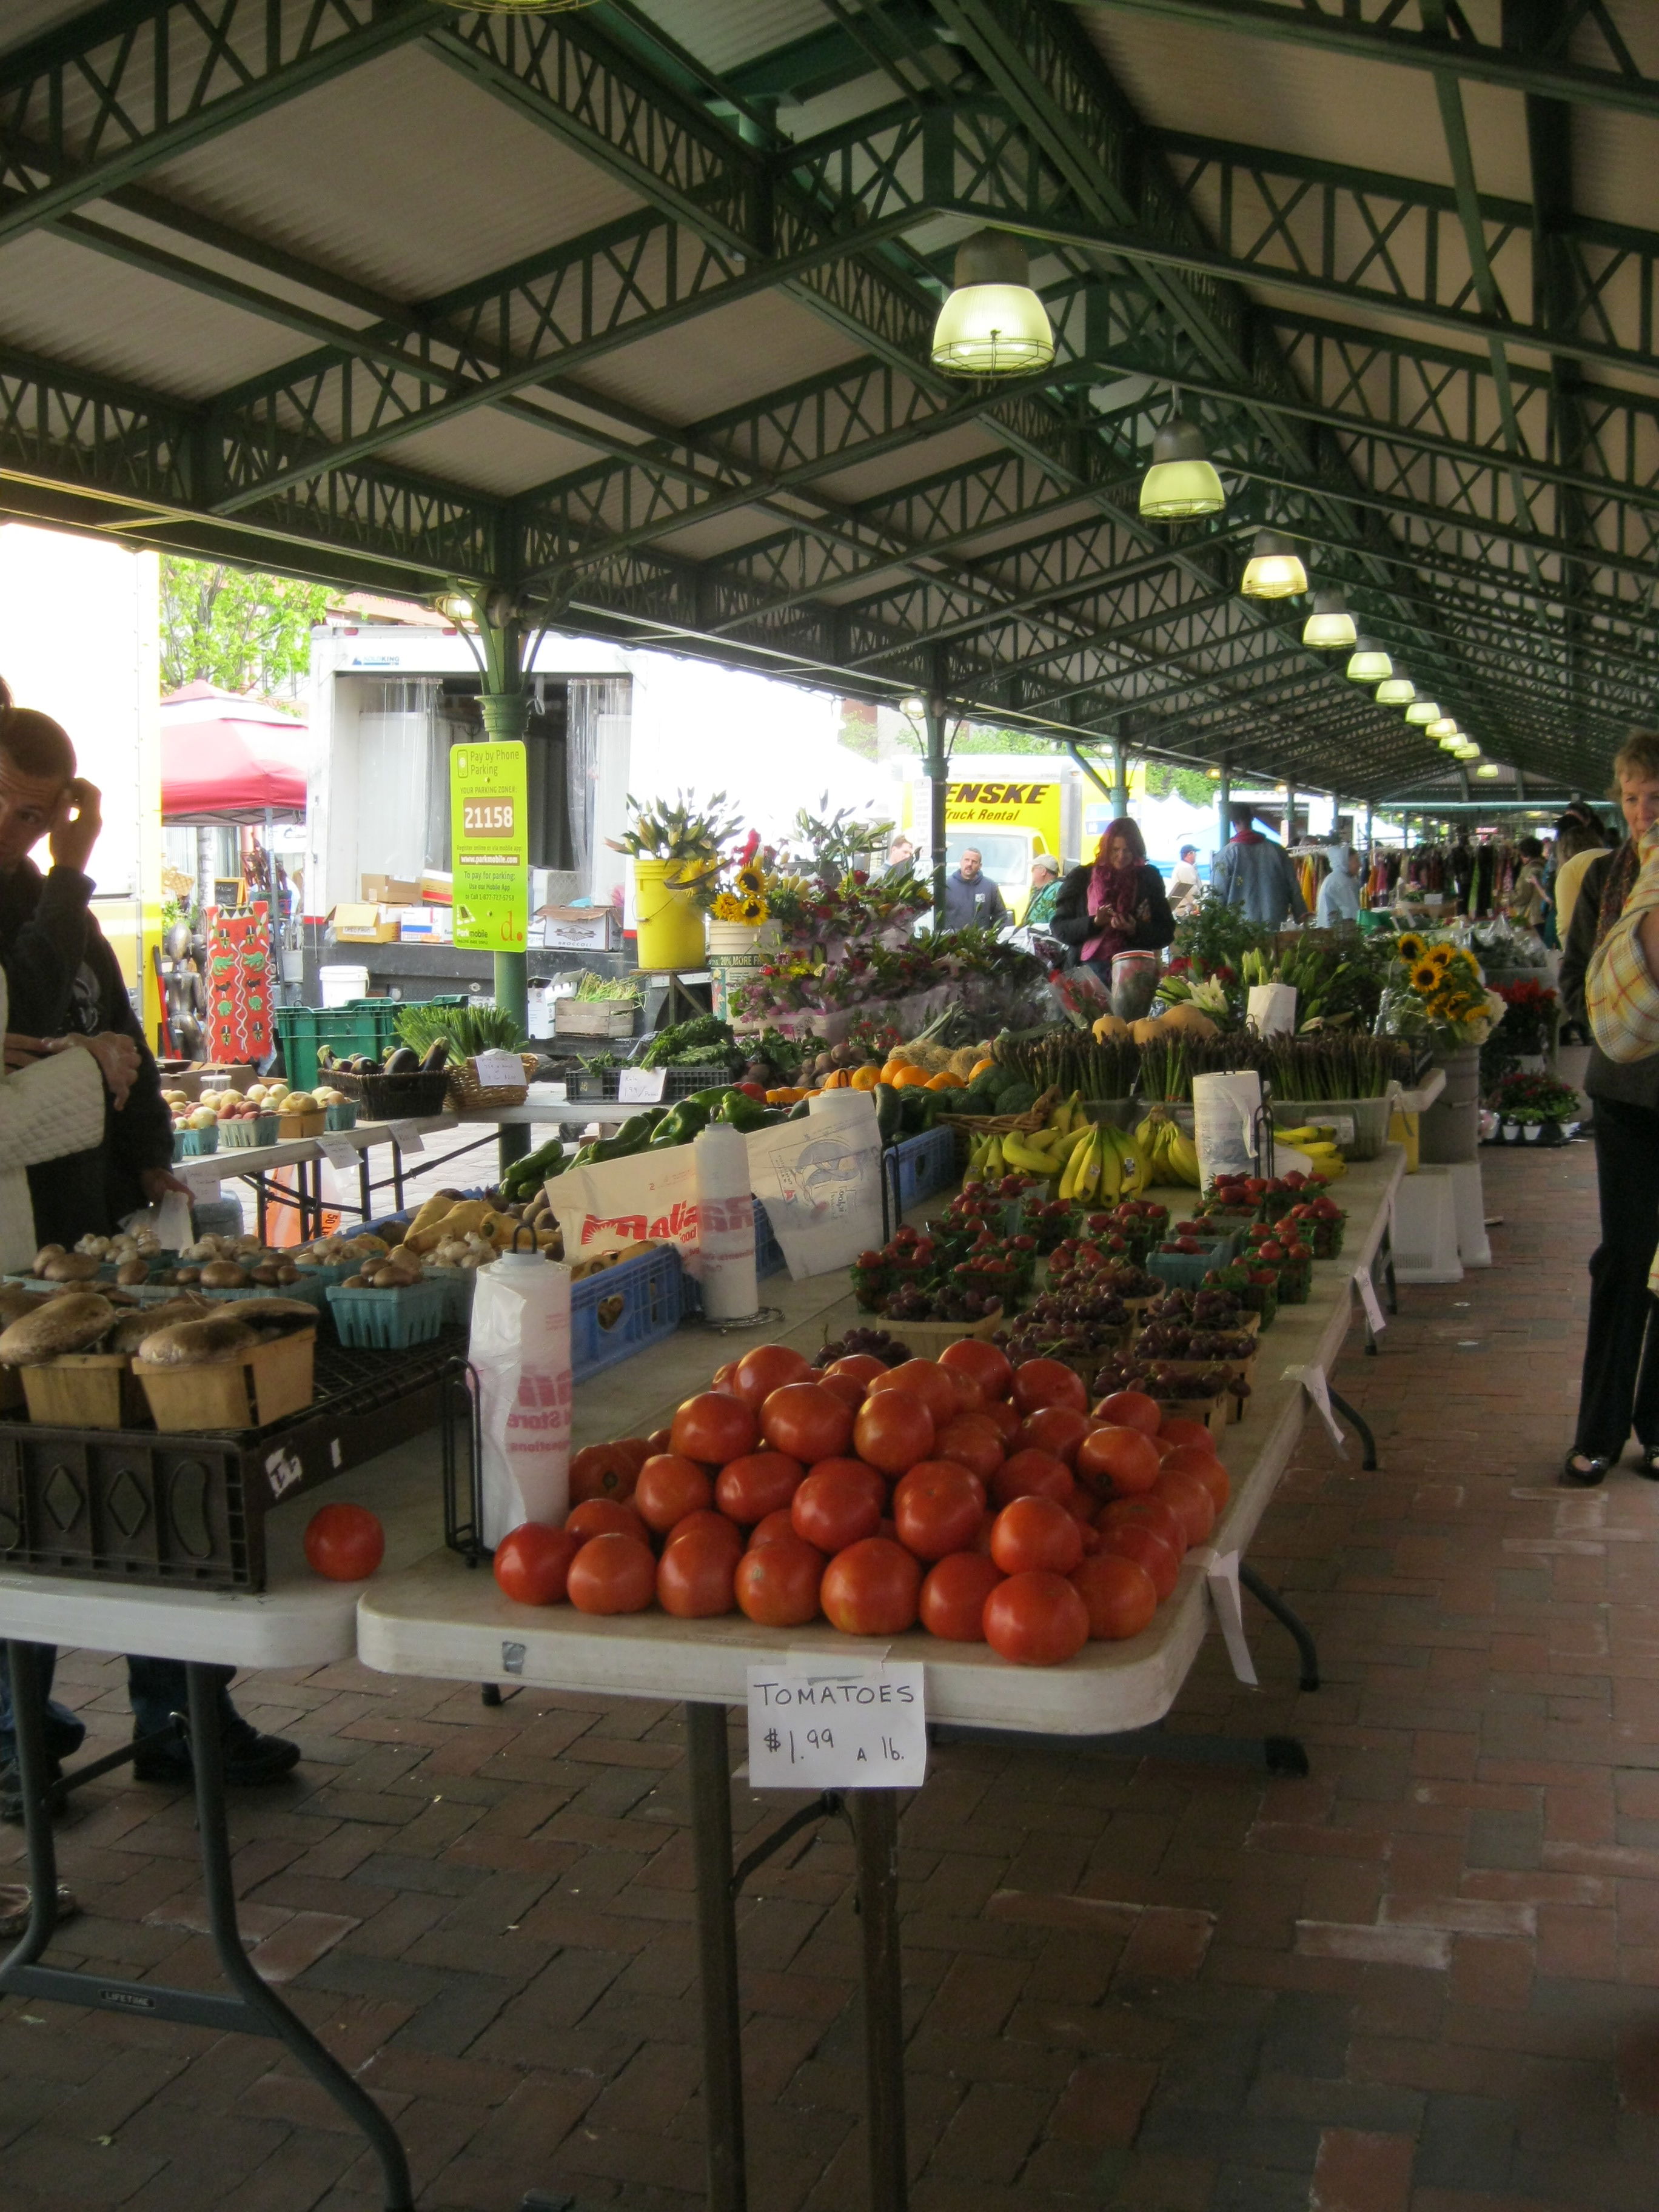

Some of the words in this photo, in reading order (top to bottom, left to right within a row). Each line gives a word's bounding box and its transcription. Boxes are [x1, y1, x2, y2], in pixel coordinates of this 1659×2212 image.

[471, 751, 483, 763] Pay
[486, 751, 494, 763] by
[496, 750, 519, 760] Phone
[471, 764, 498, 776] Parking
[945, 783, 1050, 804] ENSKE
[464, 806, 513, 829] 21158
[977, 809, 1021, 821] Rental
[461, 855, 518, 864] www.parkmobile.com
[483, 871, 491, 879] for
[492, 872, 515, 882] parking:
[732, 955, 752, 966] MORE
[325, 1213, 338, 1224] 50
[754, 1683, 914, 1706] TOMATOES
[763, 1728, 834, 1764] $1.99
[882, 1737, 905, 1760] lb.
[105, 1991, 150, 2006] LIFETIME
